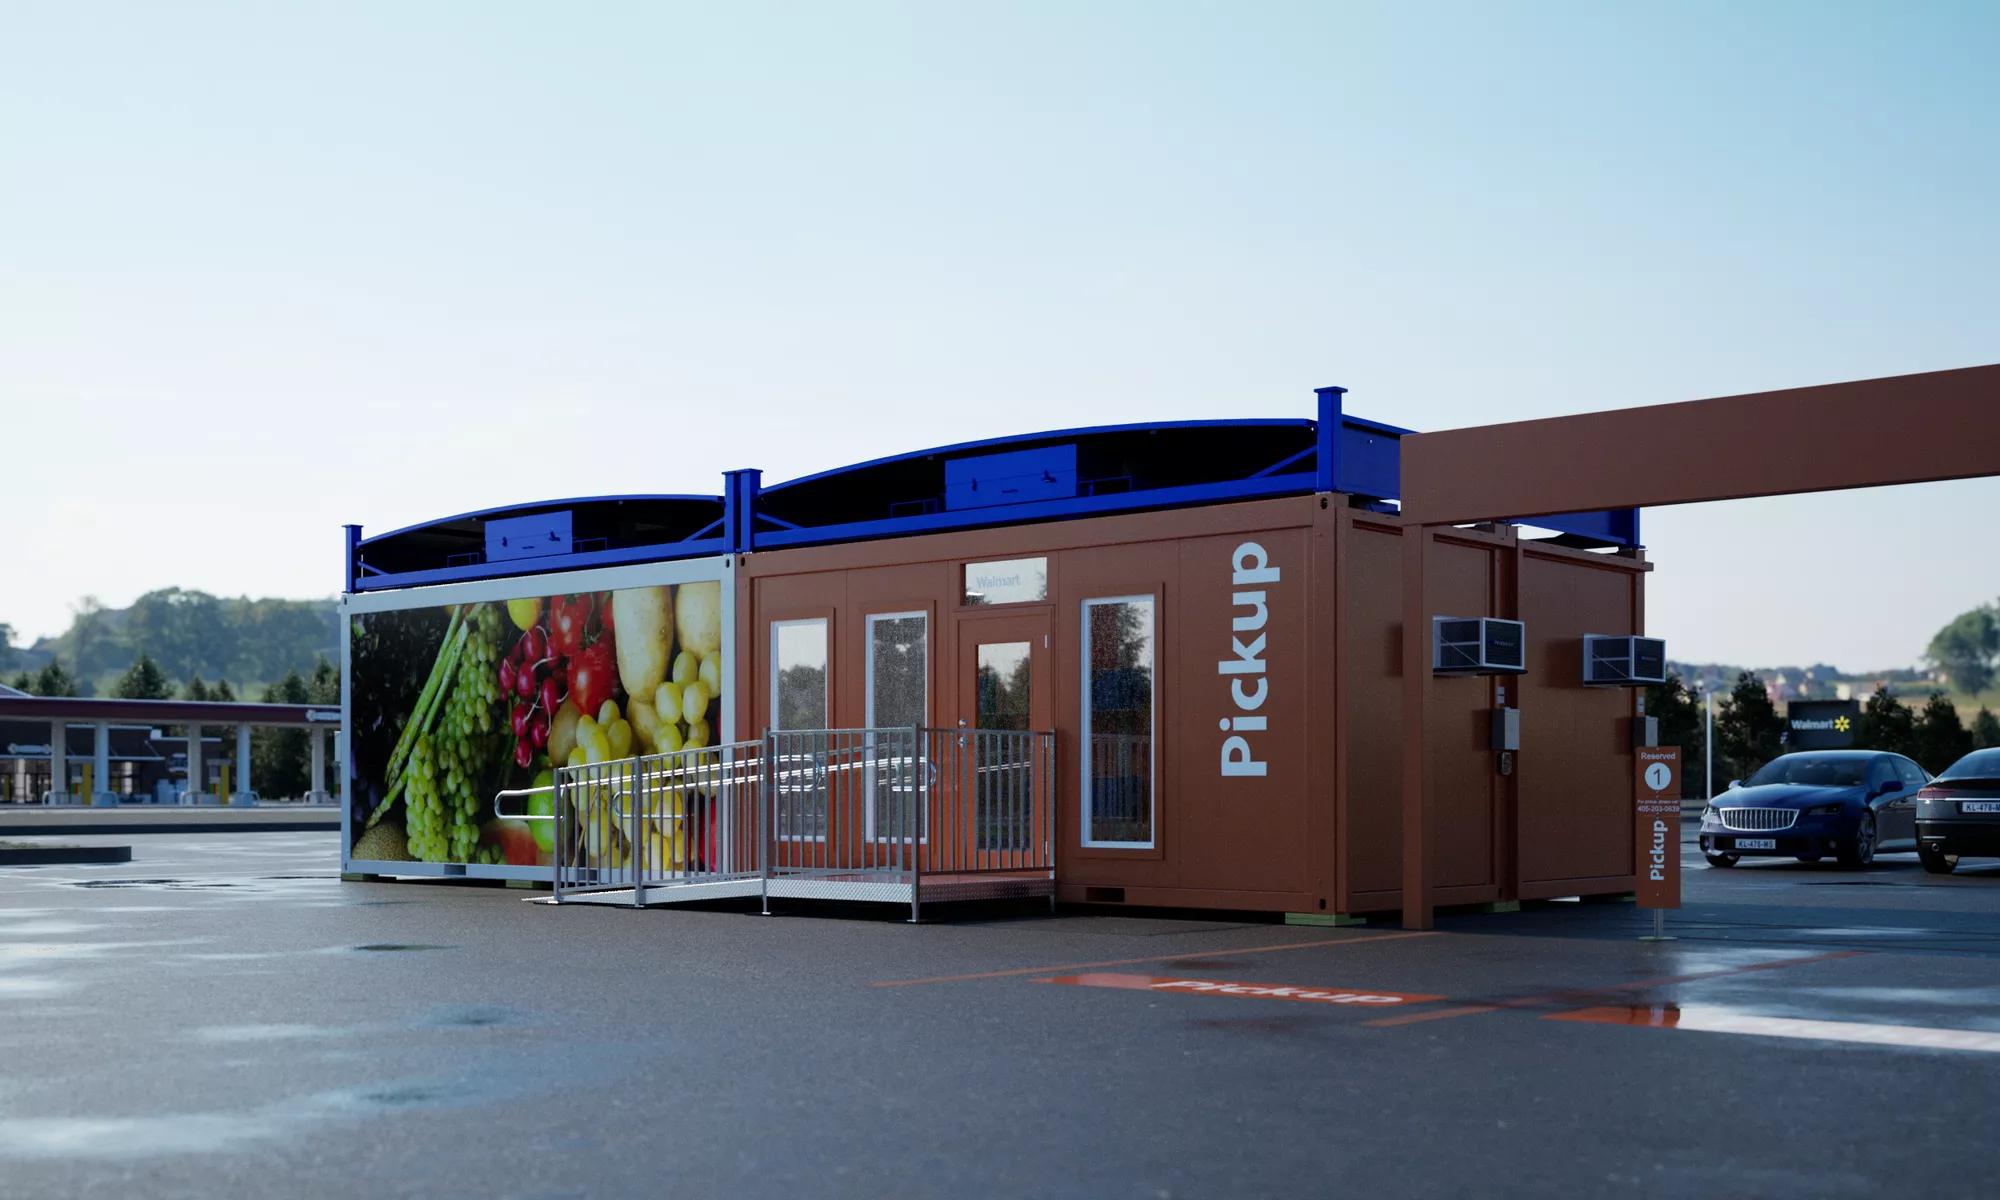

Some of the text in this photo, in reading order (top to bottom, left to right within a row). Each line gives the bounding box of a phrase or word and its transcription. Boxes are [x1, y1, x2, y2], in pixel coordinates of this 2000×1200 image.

[976, 574, 1021, 588] Walmart
[1218, 542, 1281, 777] Pickup
[1791, 719, 1833, 730] Walmart
[1640, 752, 1676, 760] Reserved
[1653, 768, 1661, 785] 1
[1650, 820, 1669, 881] Pickup
